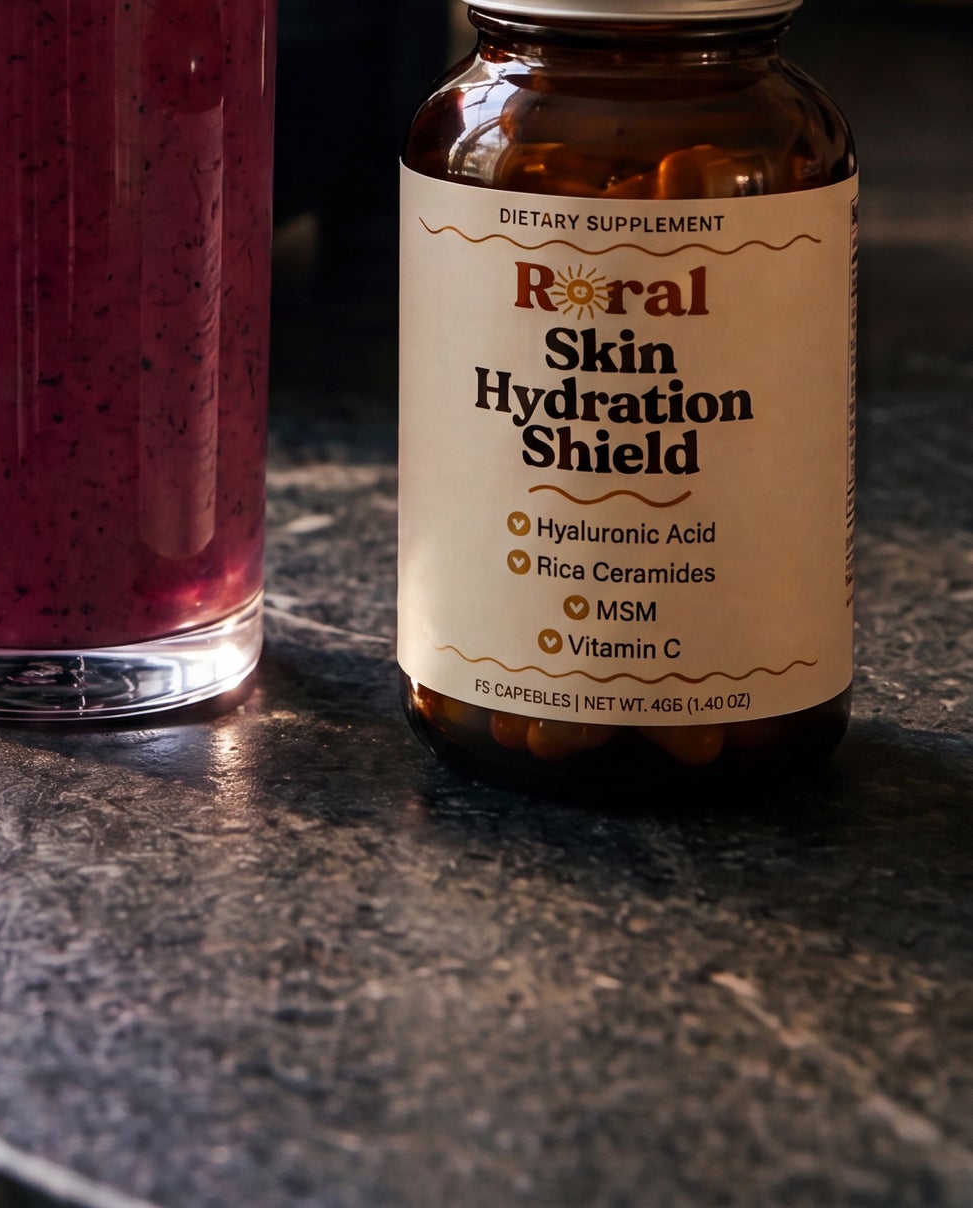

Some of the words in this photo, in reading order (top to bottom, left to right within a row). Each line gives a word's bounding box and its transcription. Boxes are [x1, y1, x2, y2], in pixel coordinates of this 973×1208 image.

[499, 207, 580, 231] DIETARY
[586, 214, 725, 233] SUPPLEMENT
[544, 326, 678, 375] Skin
[473, 366, 754, 427] Hydration
[521, 424, 701, 475] Shield
[537, 516, 660, 545] Hyaluronic
[665, 521, 716, 544] Acid
[592, 561, 716, 584] Ceramides
[596, 599, 657, 623] MSM
[567, 633, 657, 660] Vitamin
[663, 637, 682, 659] C
[494, 683, 571, 708] CAPEBLES
[584, 695, 616, 711] NET
[619, 697, 648, 713] WT.
[686, 696, 724, 715] (1.40
[726, 692, 751, 711] OZ)
